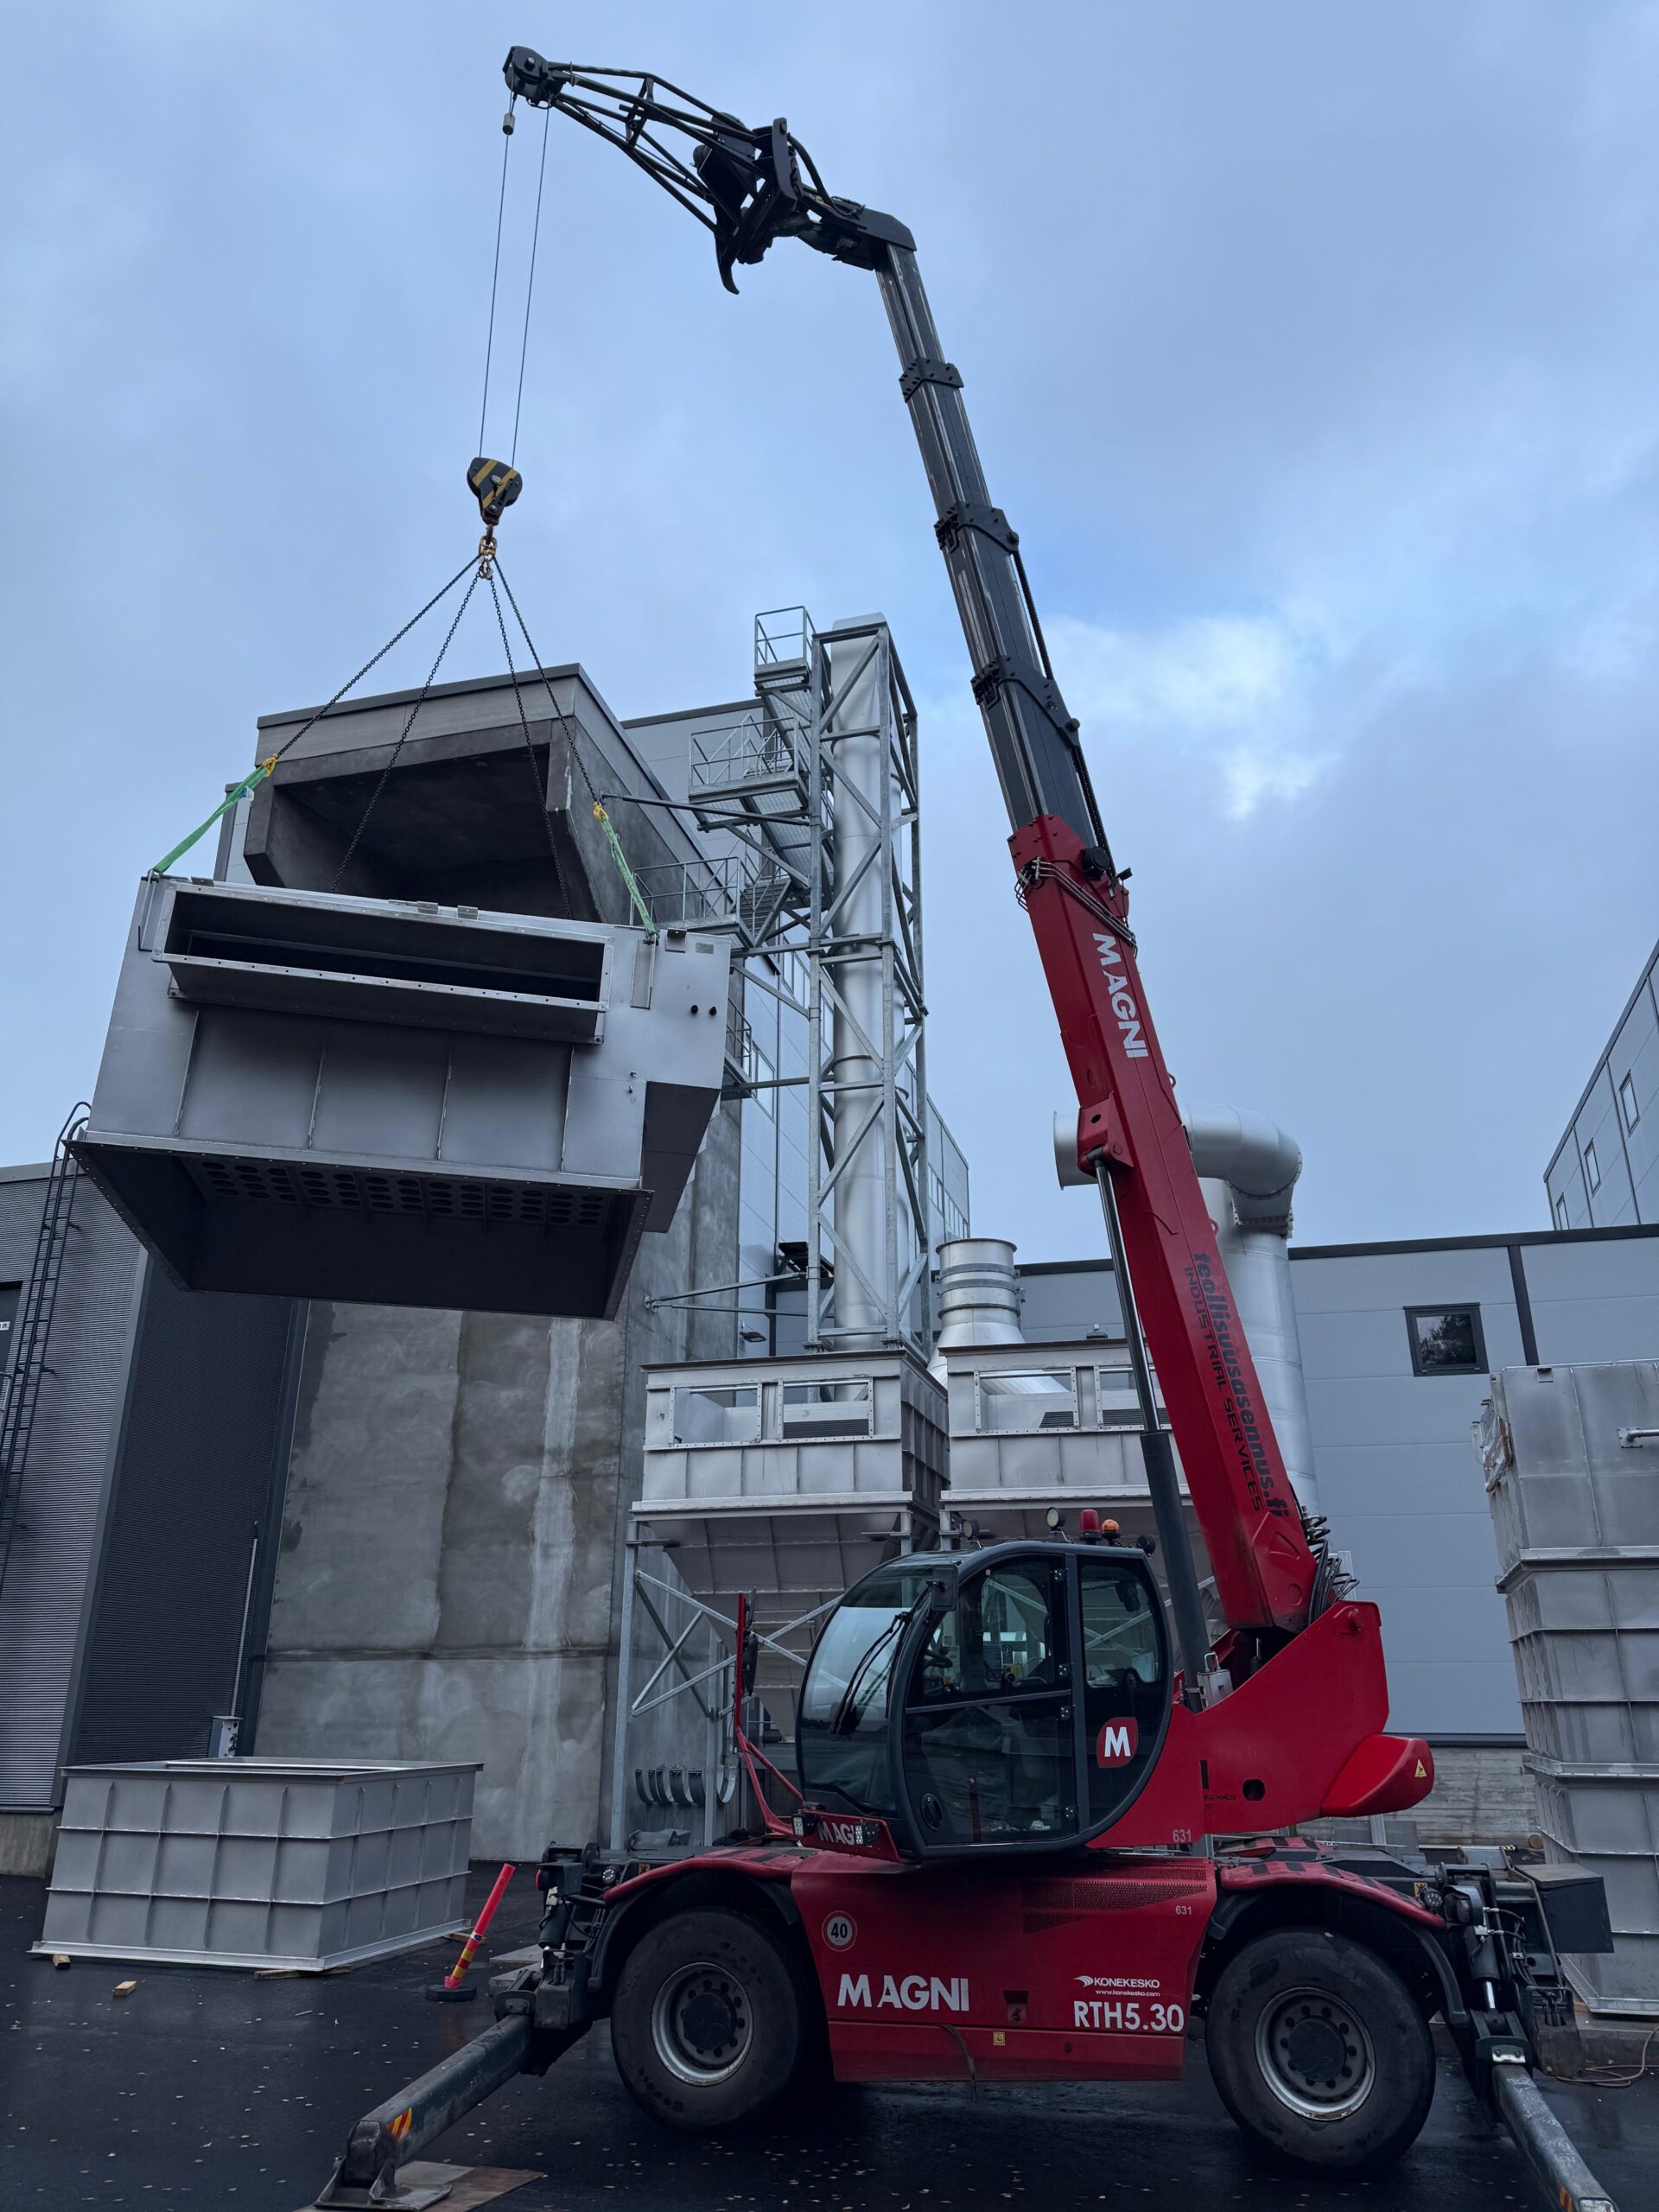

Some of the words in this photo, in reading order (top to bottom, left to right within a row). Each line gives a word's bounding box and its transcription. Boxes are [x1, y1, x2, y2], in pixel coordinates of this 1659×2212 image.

[1092, 932, 1149, 1058] MAGNI
[1184, 1266, 1228, 1394] INDUSTRIAL
[1224, 1397, 1264, 1512] SERVICES
[1192, 1252, 1290, 1517] teollisuusasennus.fi
[1104, 1726, 1131, 1758] M
[1173, 1828, 1192, 1842] 631
[1175, 1905, 1192, 1916] 631
[831, 1923, 848, 1938] 40
[837, 1974, 969, 2012] MAGNI
[1094, 1977, 1160, 1988] KONEKESKO
[1095, 1989, 1160, 1998] www.konekesko.com
[1073, 2000, 1185, 2032] RTH5.30
